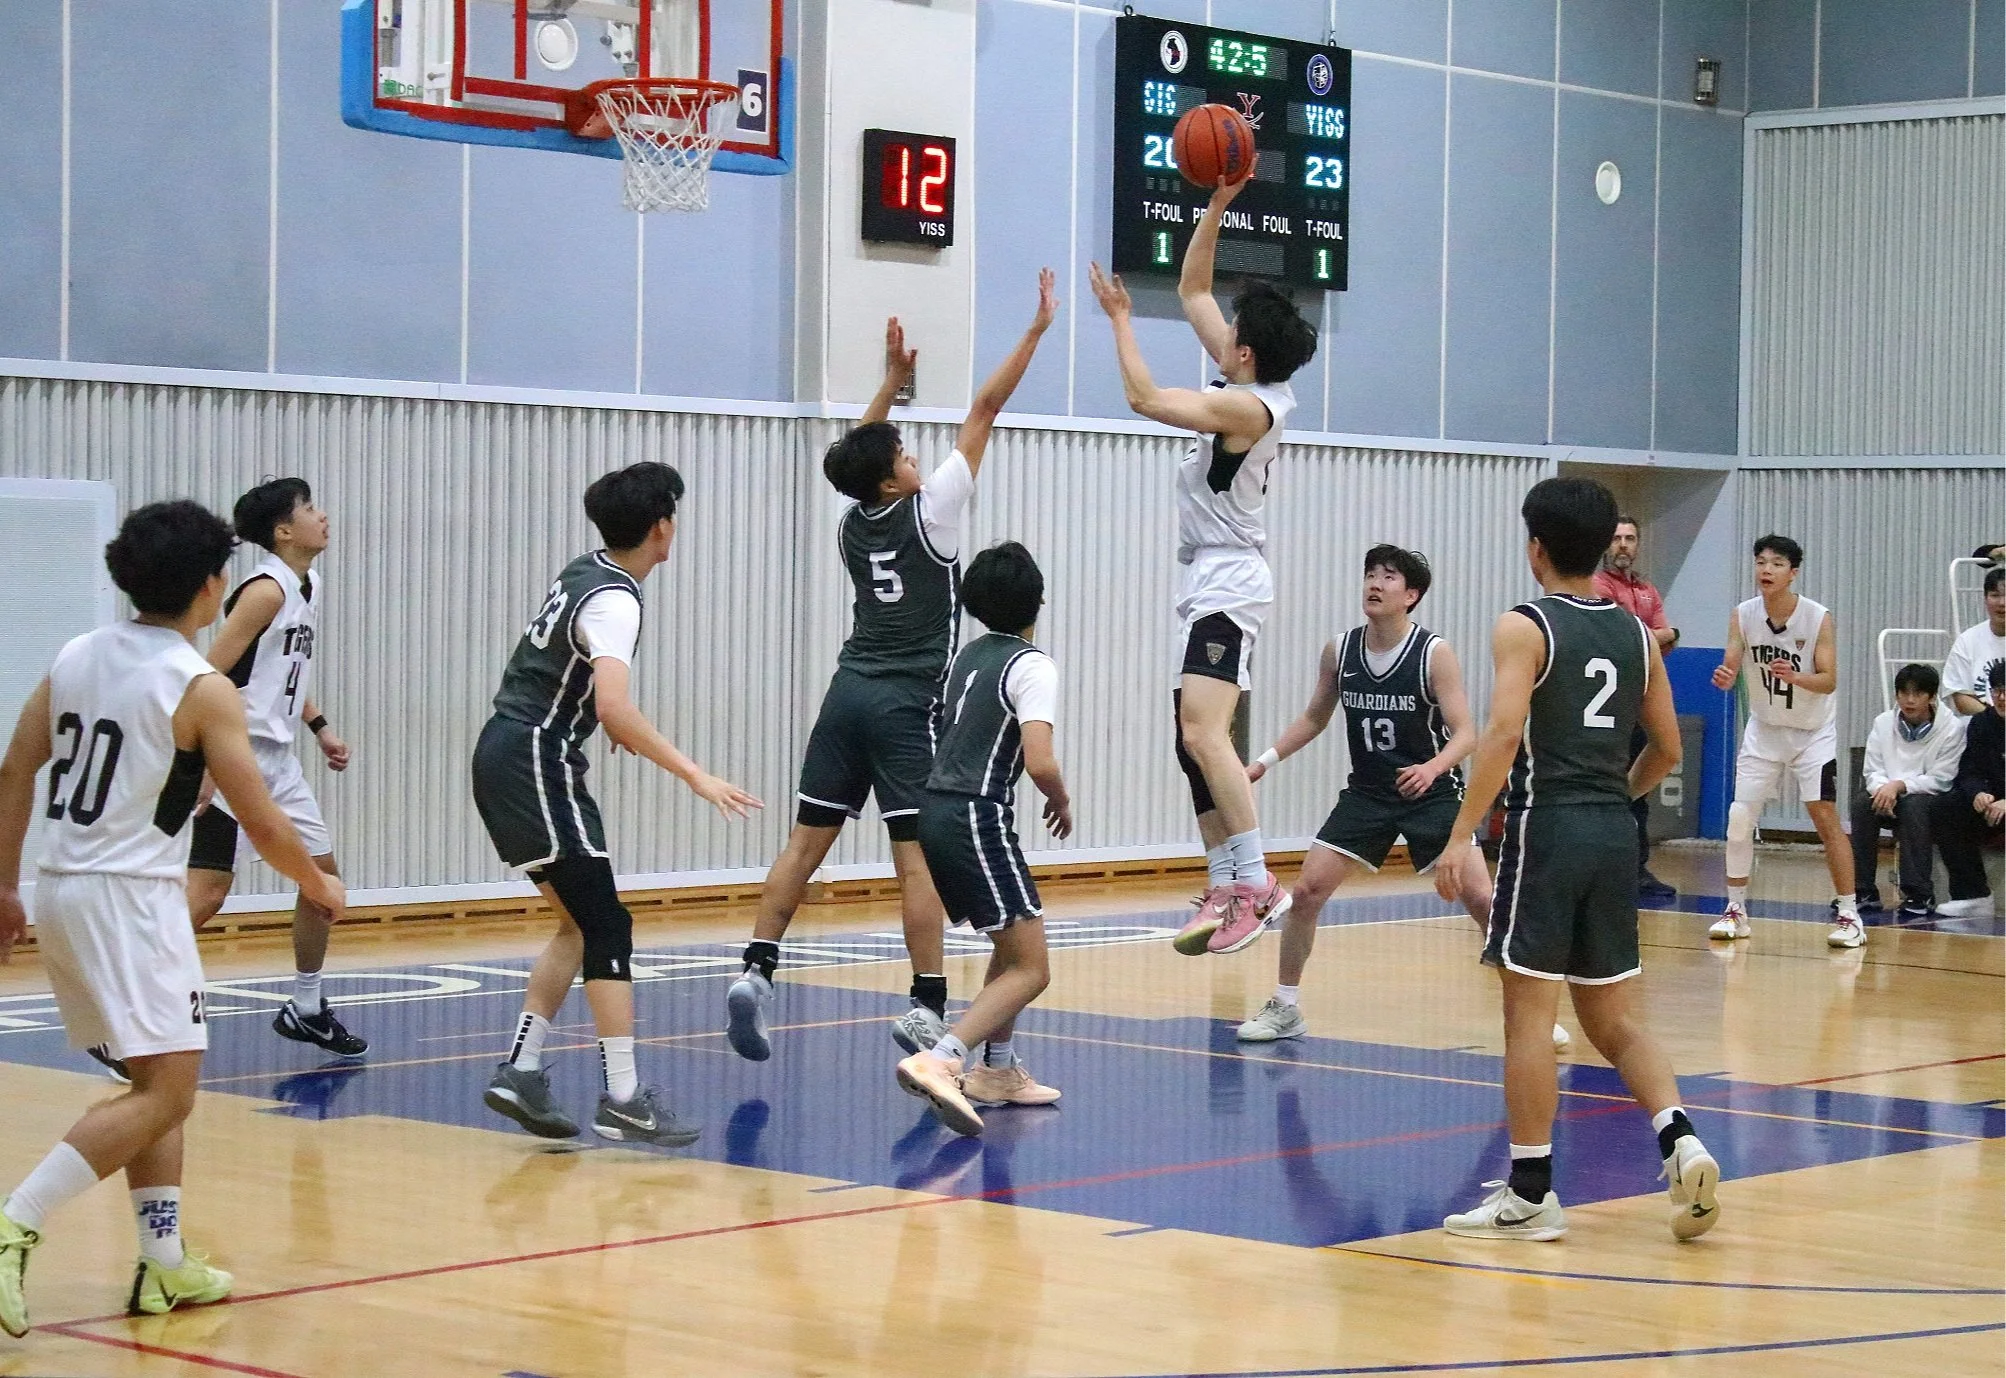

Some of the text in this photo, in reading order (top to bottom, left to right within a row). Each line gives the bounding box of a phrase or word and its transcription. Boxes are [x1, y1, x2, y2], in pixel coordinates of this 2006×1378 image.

[742, 82, 763, 117] 6
[1305, 104, 1345, 139] YISS
[901, 147, 947, 213] 12
[1305, 156, 1343, 189] 23
[919, 221, 946, 237] YISS
[1143, 201, 1184, 223] T-FOUL
[1262, 215, 1292, 235] FOUL
[1305, 219, 1343, 240] T-FOUL
[1157, 232, 1169, 263] 1
[1317, 249, 1330, 279] 1
[869, 550, 905, 603] 5
[284, 661, 301, 716] 4
[954, 669, 979, 725] 1
[1342, 690, 1417, 712] GUARDIANS
[1583, 657, 1618, 729] 2
[1759, 666, 1794, 710] 44
[1361, 717, 1397, 753] 13
[46, 712, 124, 827] 20
[190, 991, 206, 1024] 2
